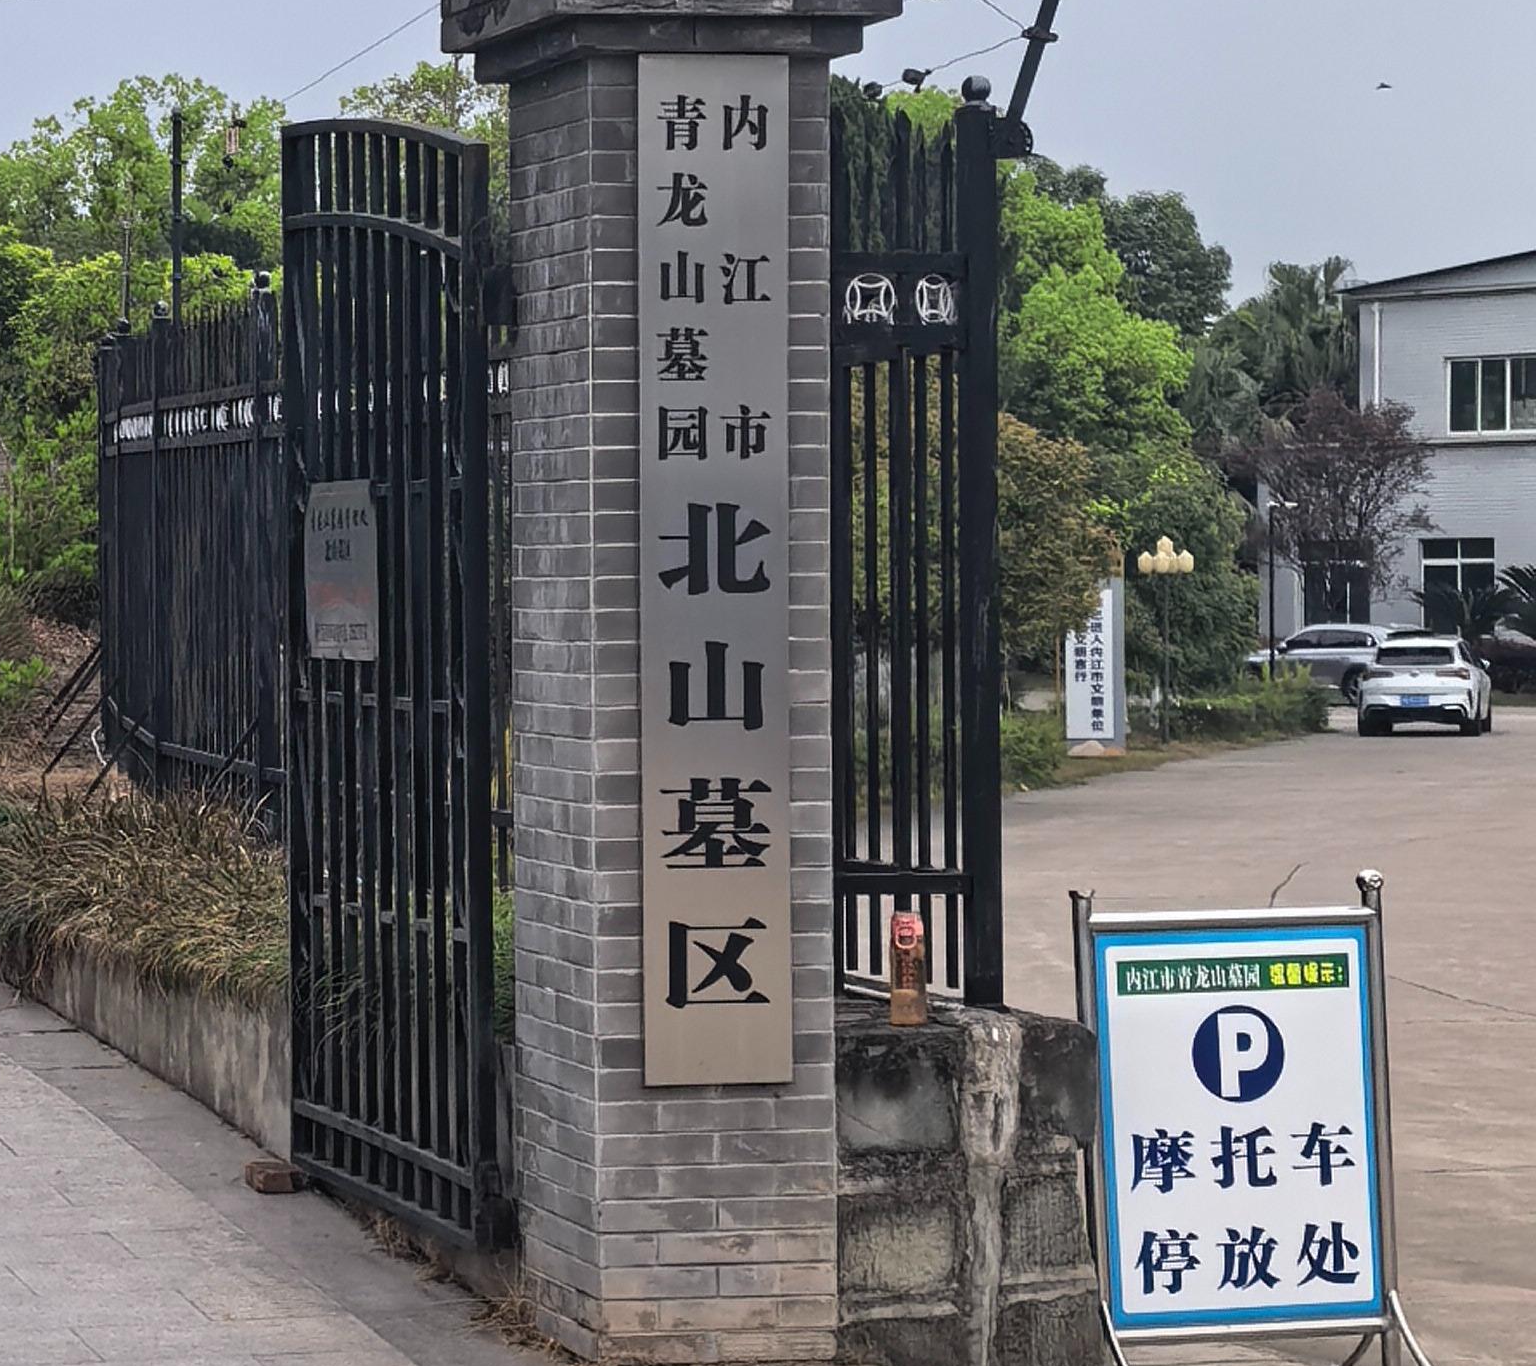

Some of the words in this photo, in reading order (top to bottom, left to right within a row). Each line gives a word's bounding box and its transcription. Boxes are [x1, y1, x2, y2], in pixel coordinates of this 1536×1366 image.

[656, 94, 710, 461] 青龙山墓园
[720, 94, 771, 461] 内江市
[658, 502, 772, 1009] 北山墓区
[1125, 962, 1261, 992] 内江市青龙山墓园
[1217, 1012, 1270, 1098] P
[1130, 1122, 1355, 1193] 摩托车
[1135, 1221, 1360, 1295] 停放处
